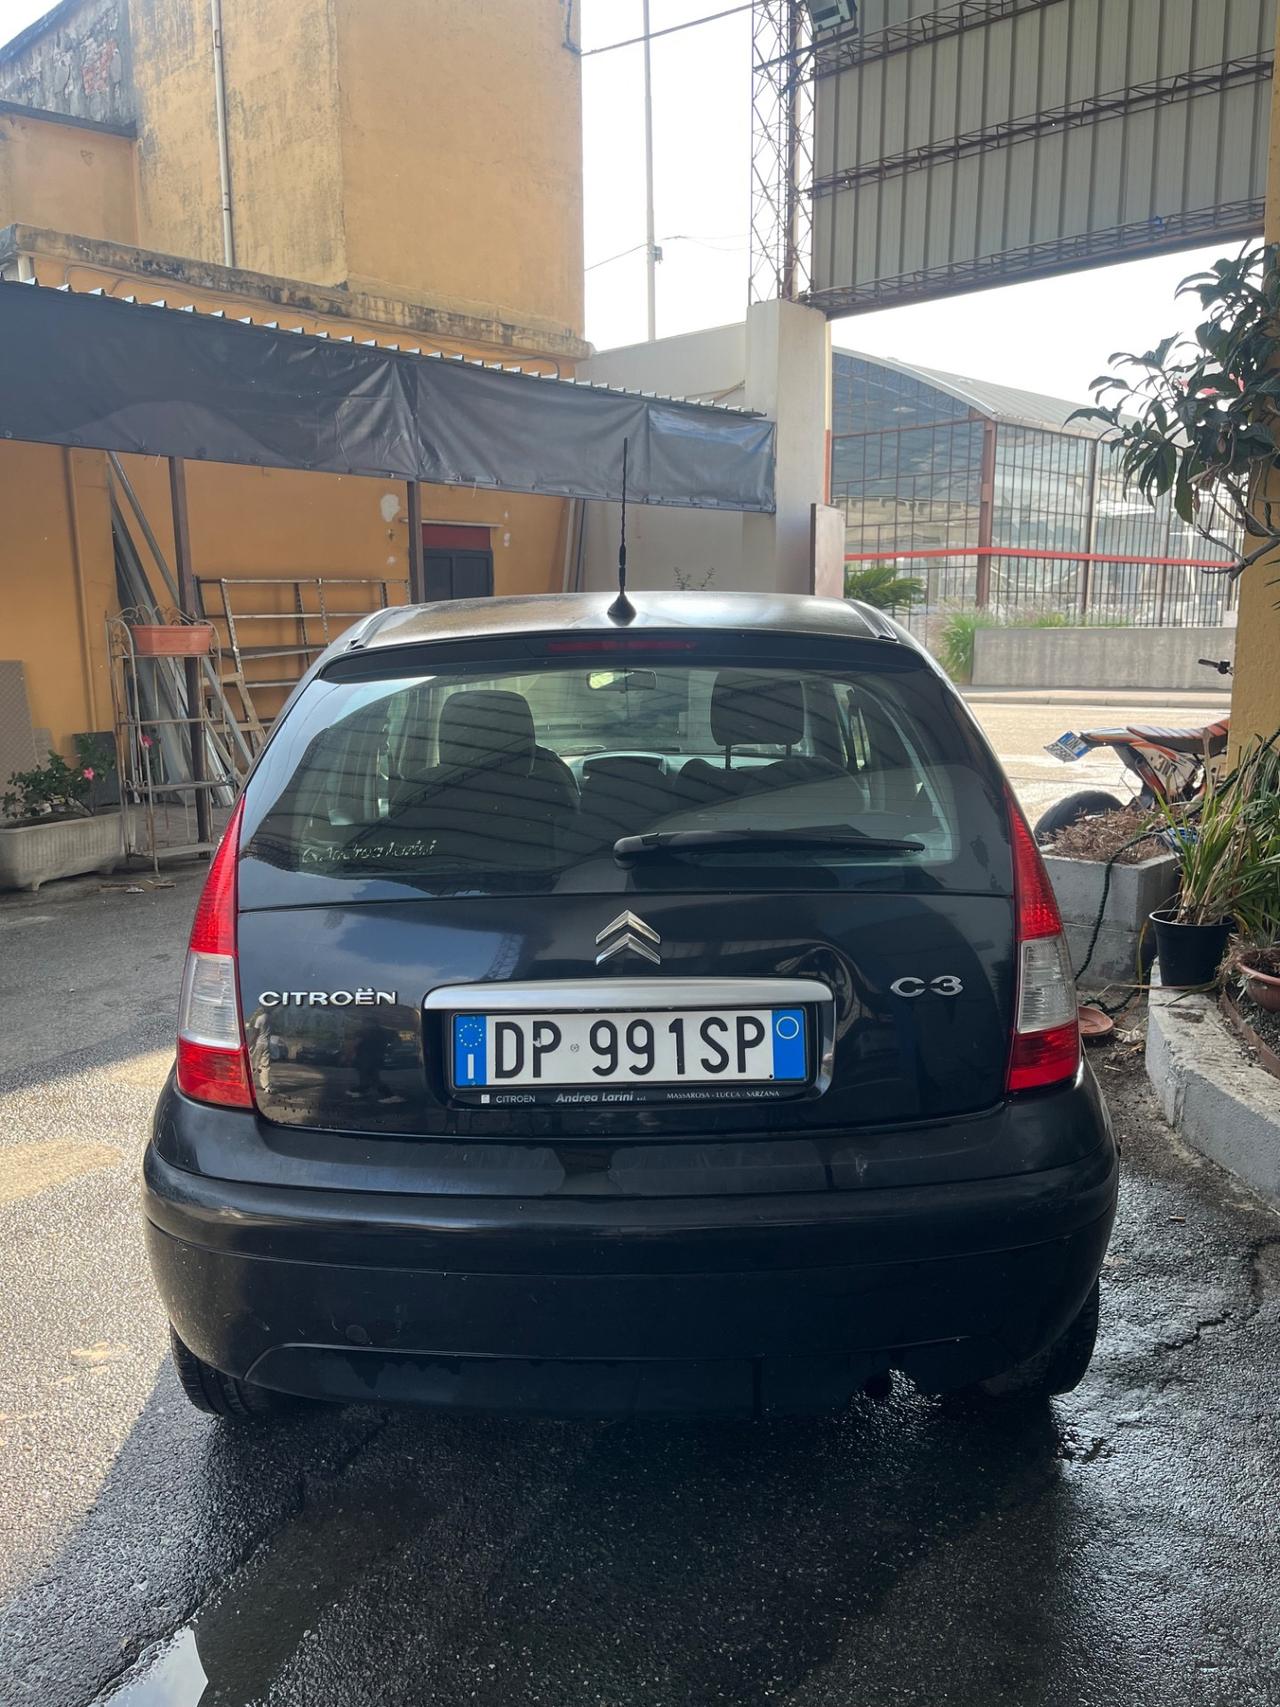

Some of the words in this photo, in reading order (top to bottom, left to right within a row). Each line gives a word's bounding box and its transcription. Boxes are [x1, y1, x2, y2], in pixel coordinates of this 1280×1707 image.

[258, 987, 396, 1007] CITROËN
[495, 1020, 562, 1079] DP
[589, 1015, 766, 1077] 991SP
[556, 1092, 599, 1103] Andrea
[601, 1090, 634, 1103] Larini
[666, 1091, 711, 1100] MASSAROSA
[716, 1090, 741, 1099] LUCCA
[746, 1089, 780, 1098] SARZANA
